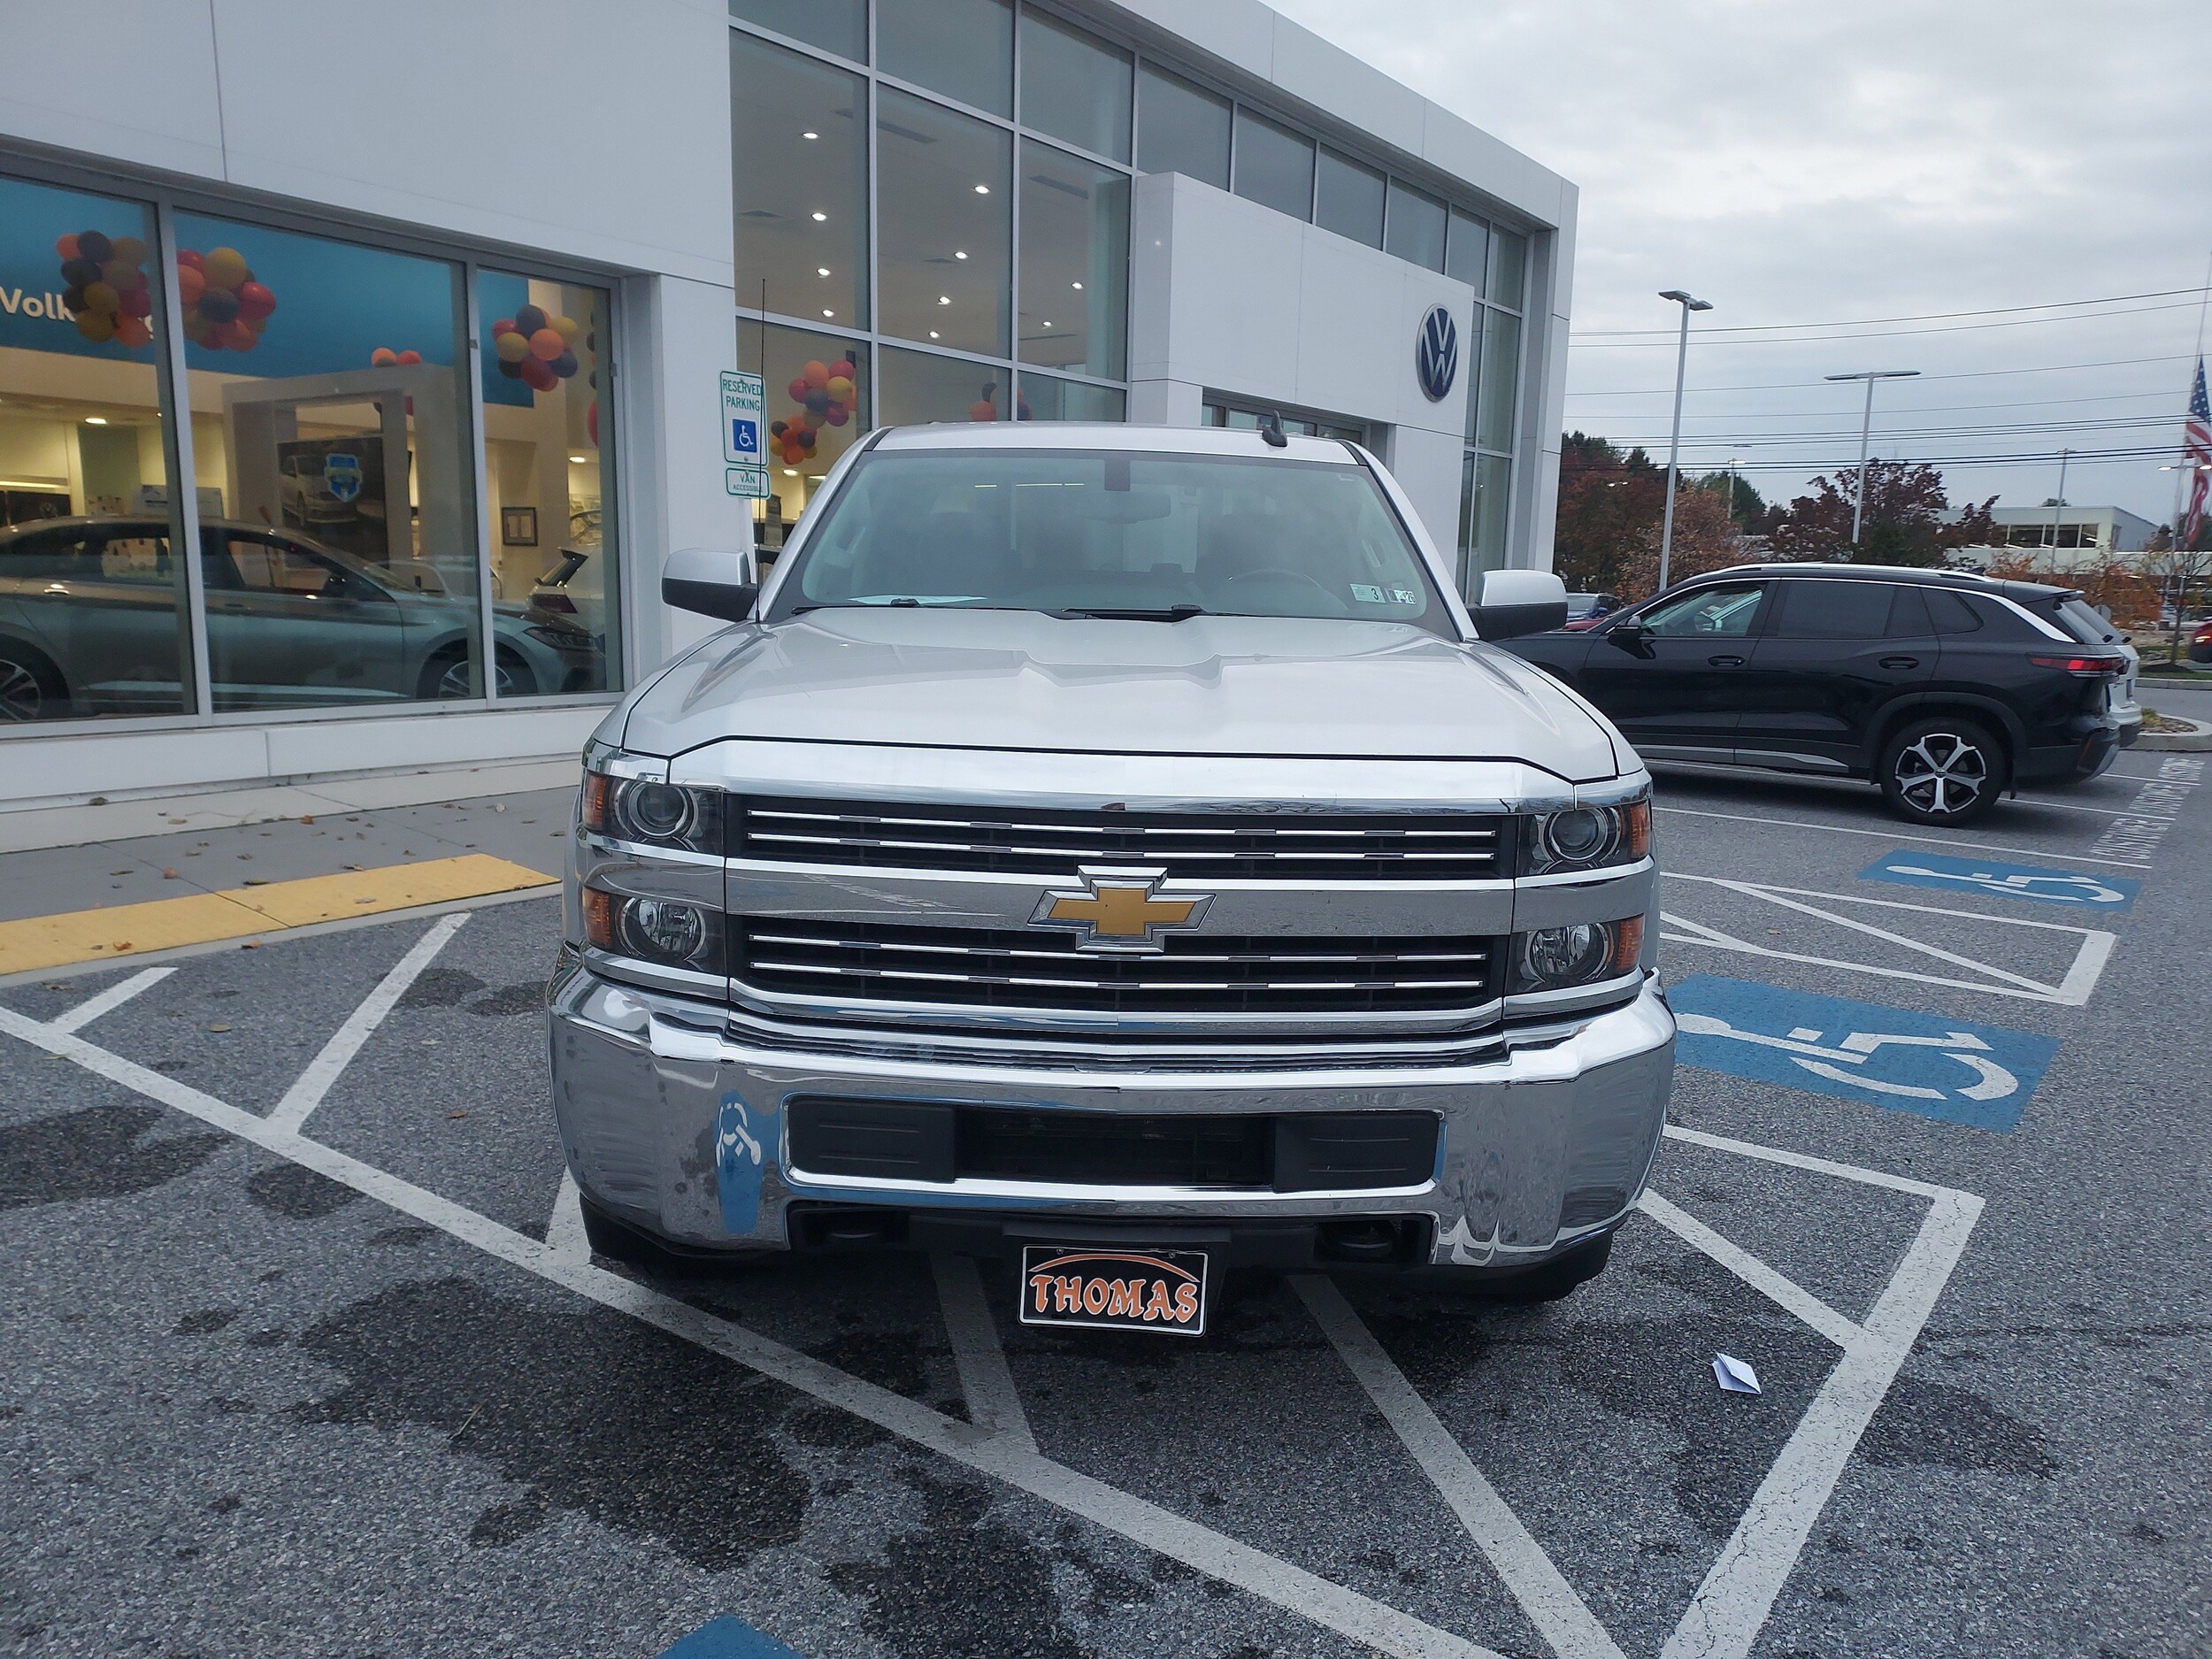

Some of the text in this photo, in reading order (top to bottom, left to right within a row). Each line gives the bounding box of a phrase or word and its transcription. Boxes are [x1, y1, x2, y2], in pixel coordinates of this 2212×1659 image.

[722, 379, 764, 396] RESERVED
[726, 396, 761, 411] PARKING
[740, 472, 756, 484] VAN
[1371, 588, 1379, 601] 3
[1029, 1274, 1199, 1324] THOMAS
